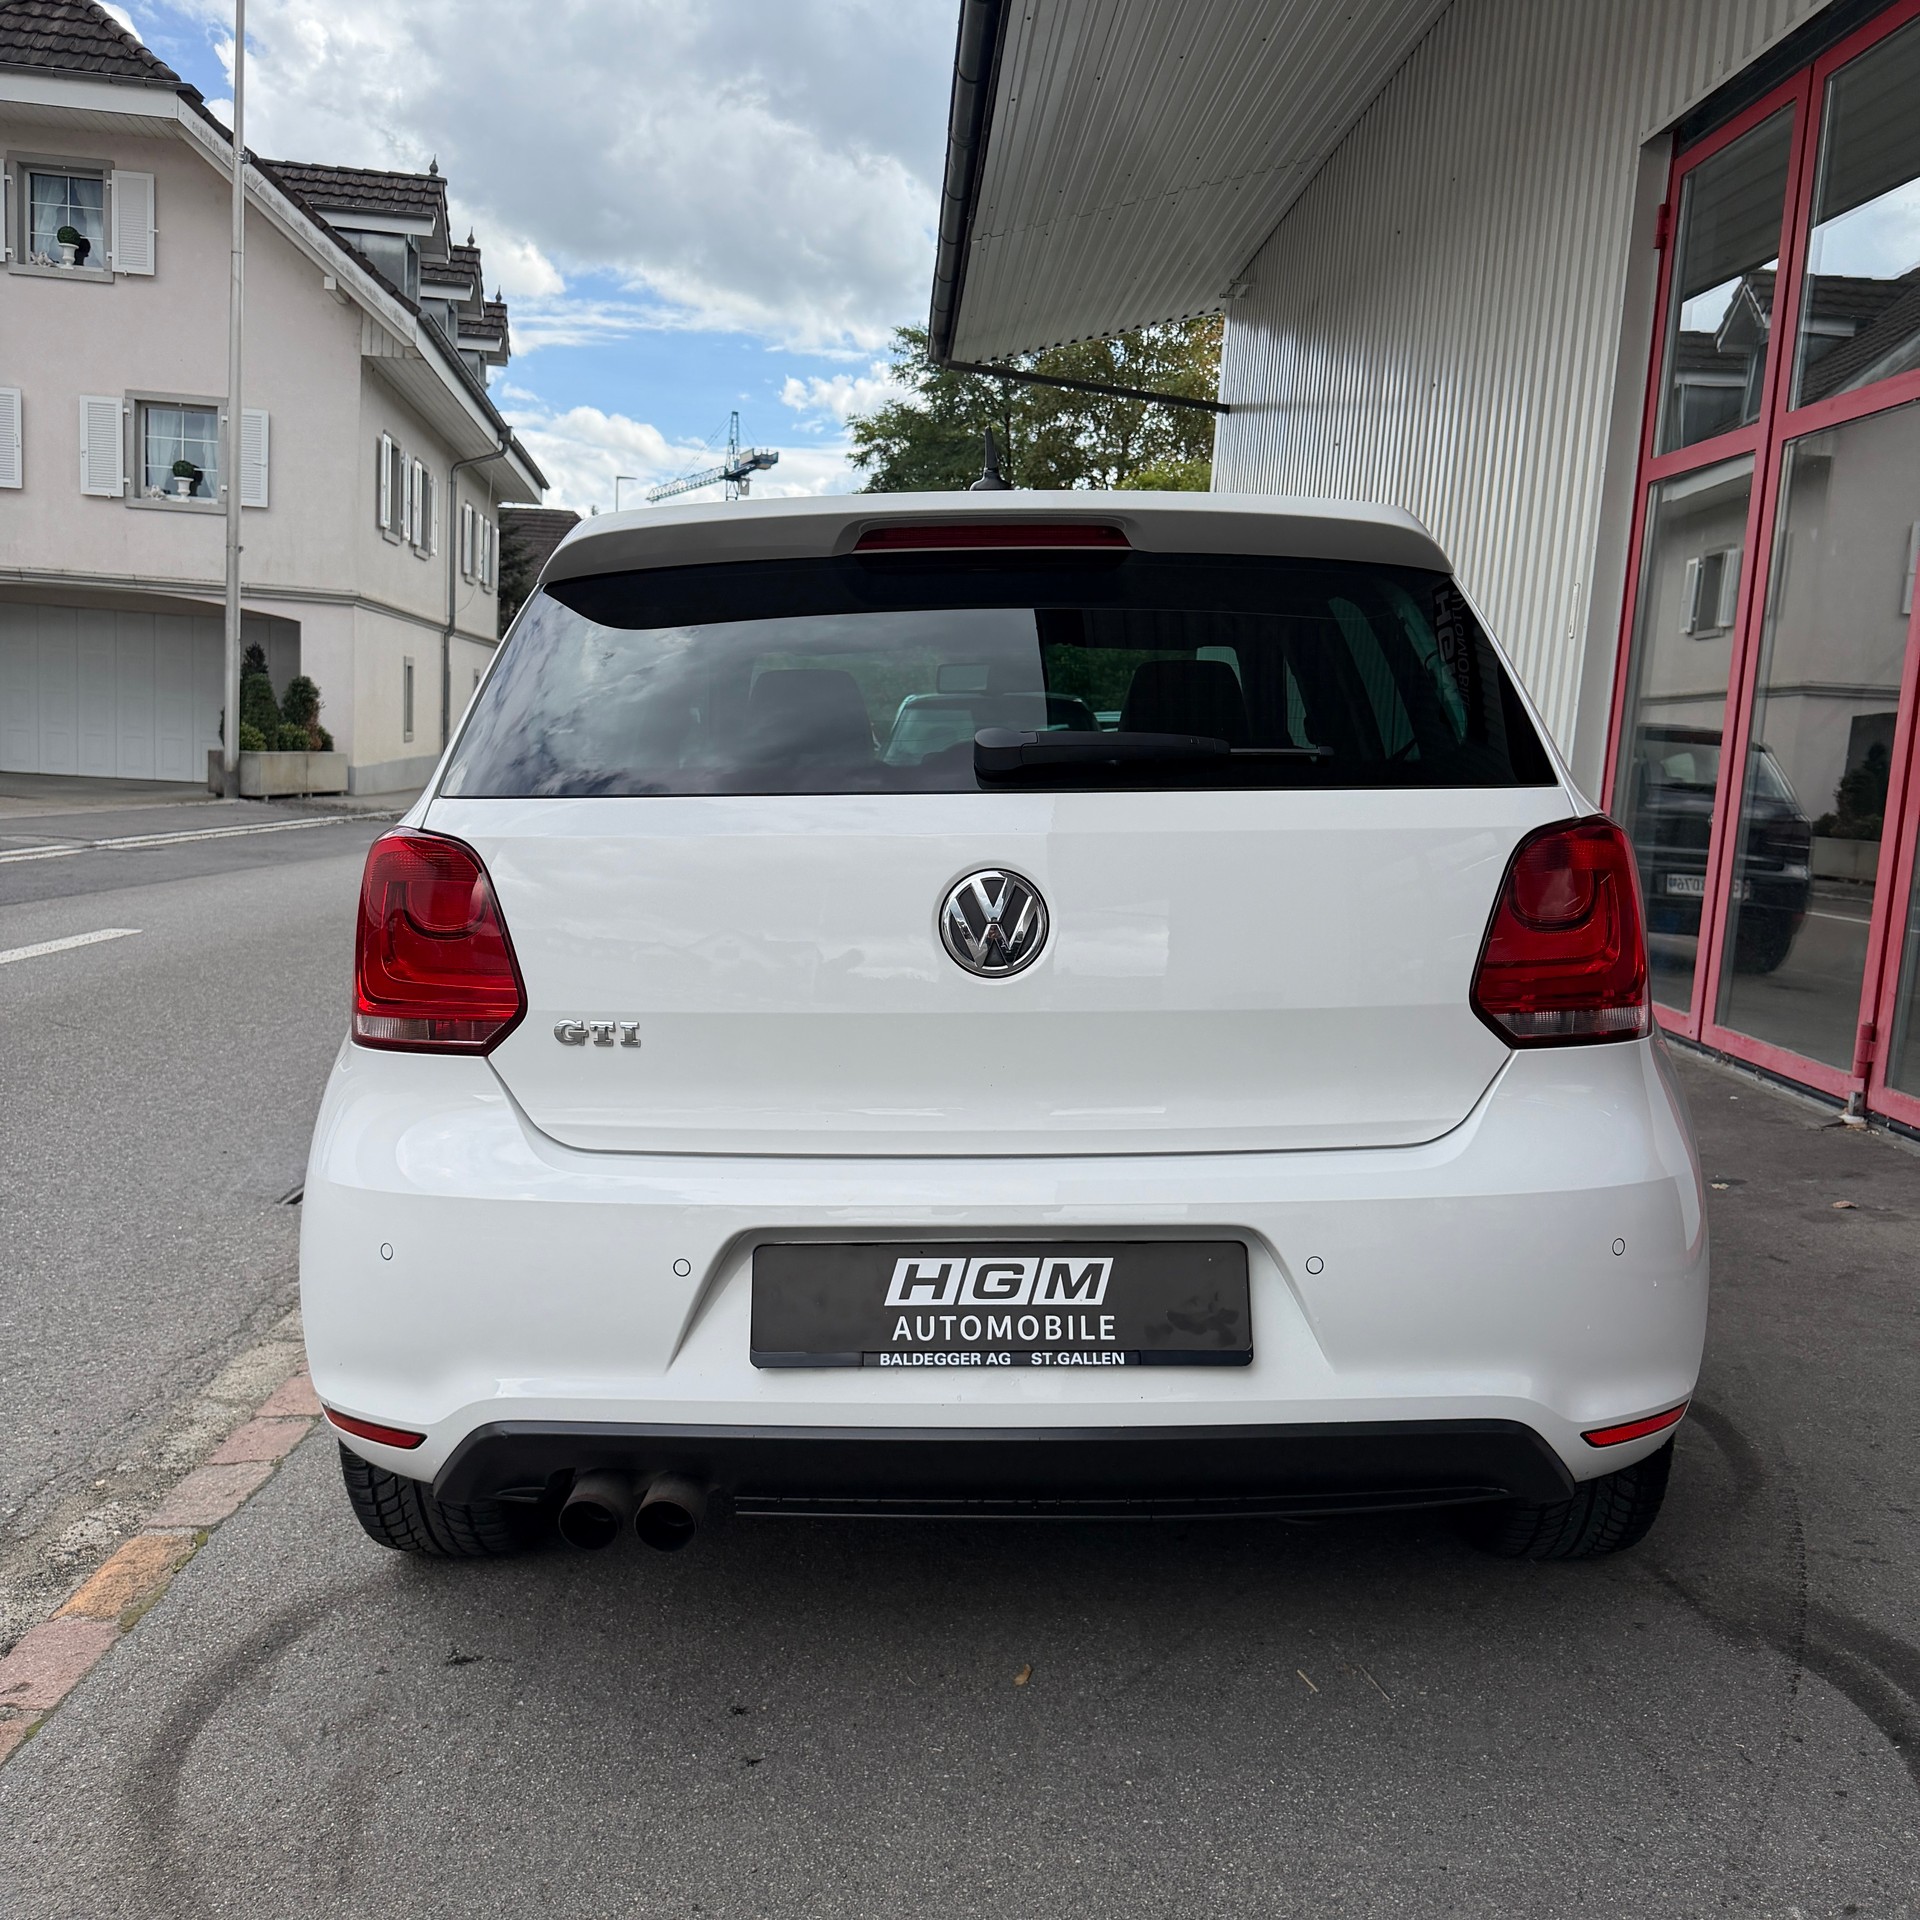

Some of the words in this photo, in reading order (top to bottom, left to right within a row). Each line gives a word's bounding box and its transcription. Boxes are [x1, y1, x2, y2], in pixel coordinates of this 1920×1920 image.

[942, 871, 1046, 976] VW
[553, 1019, 641, 1047] GTI
[895, 1261, 1107, 1301] HGM
[892, 1315, 1116, 1341] AUTOMOBILE
[879, 1353, 982, 1366] BALDEGGER
[986, 1353, 1011, 1366] AG
[1031, 1352, 1125, 1366] ST.GALLEN
